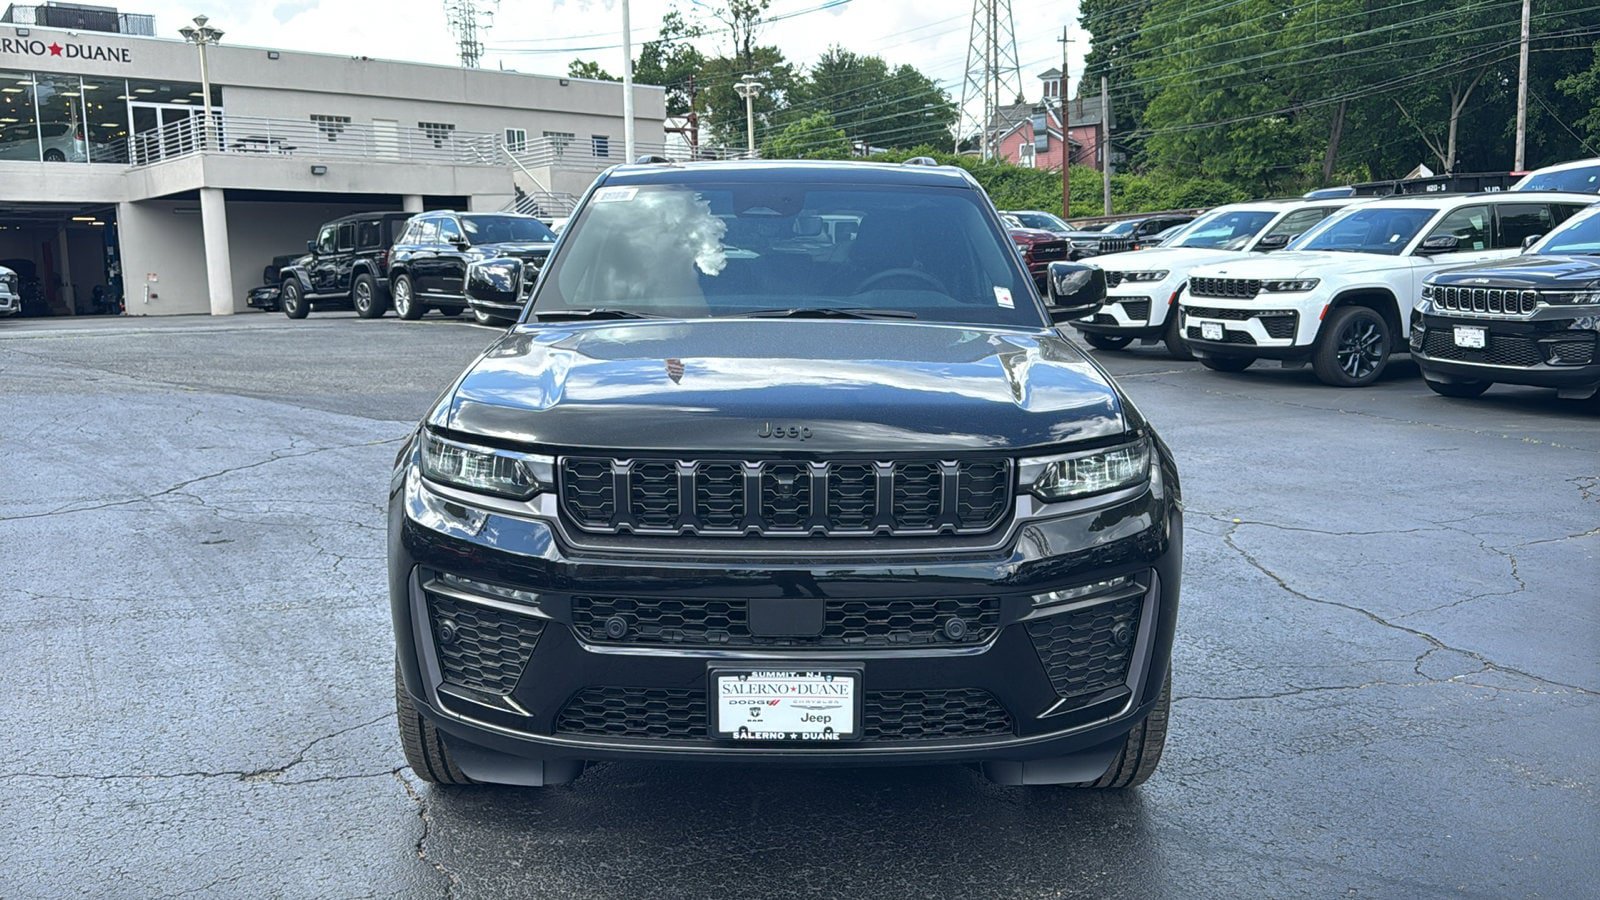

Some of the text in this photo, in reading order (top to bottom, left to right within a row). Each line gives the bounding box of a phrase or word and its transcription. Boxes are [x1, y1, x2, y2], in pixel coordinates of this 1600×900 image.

[0, 38, 132, 63] RNO DUANE
[757, 421, 814, 442] Jeep
[806, 671, 821, 679] NJ
[722, 683, 849, 696] SALERNO DUANE
[800, 712, 832, 725] Jeep
[732, 731, 840, 740] SALERNO DUANE
